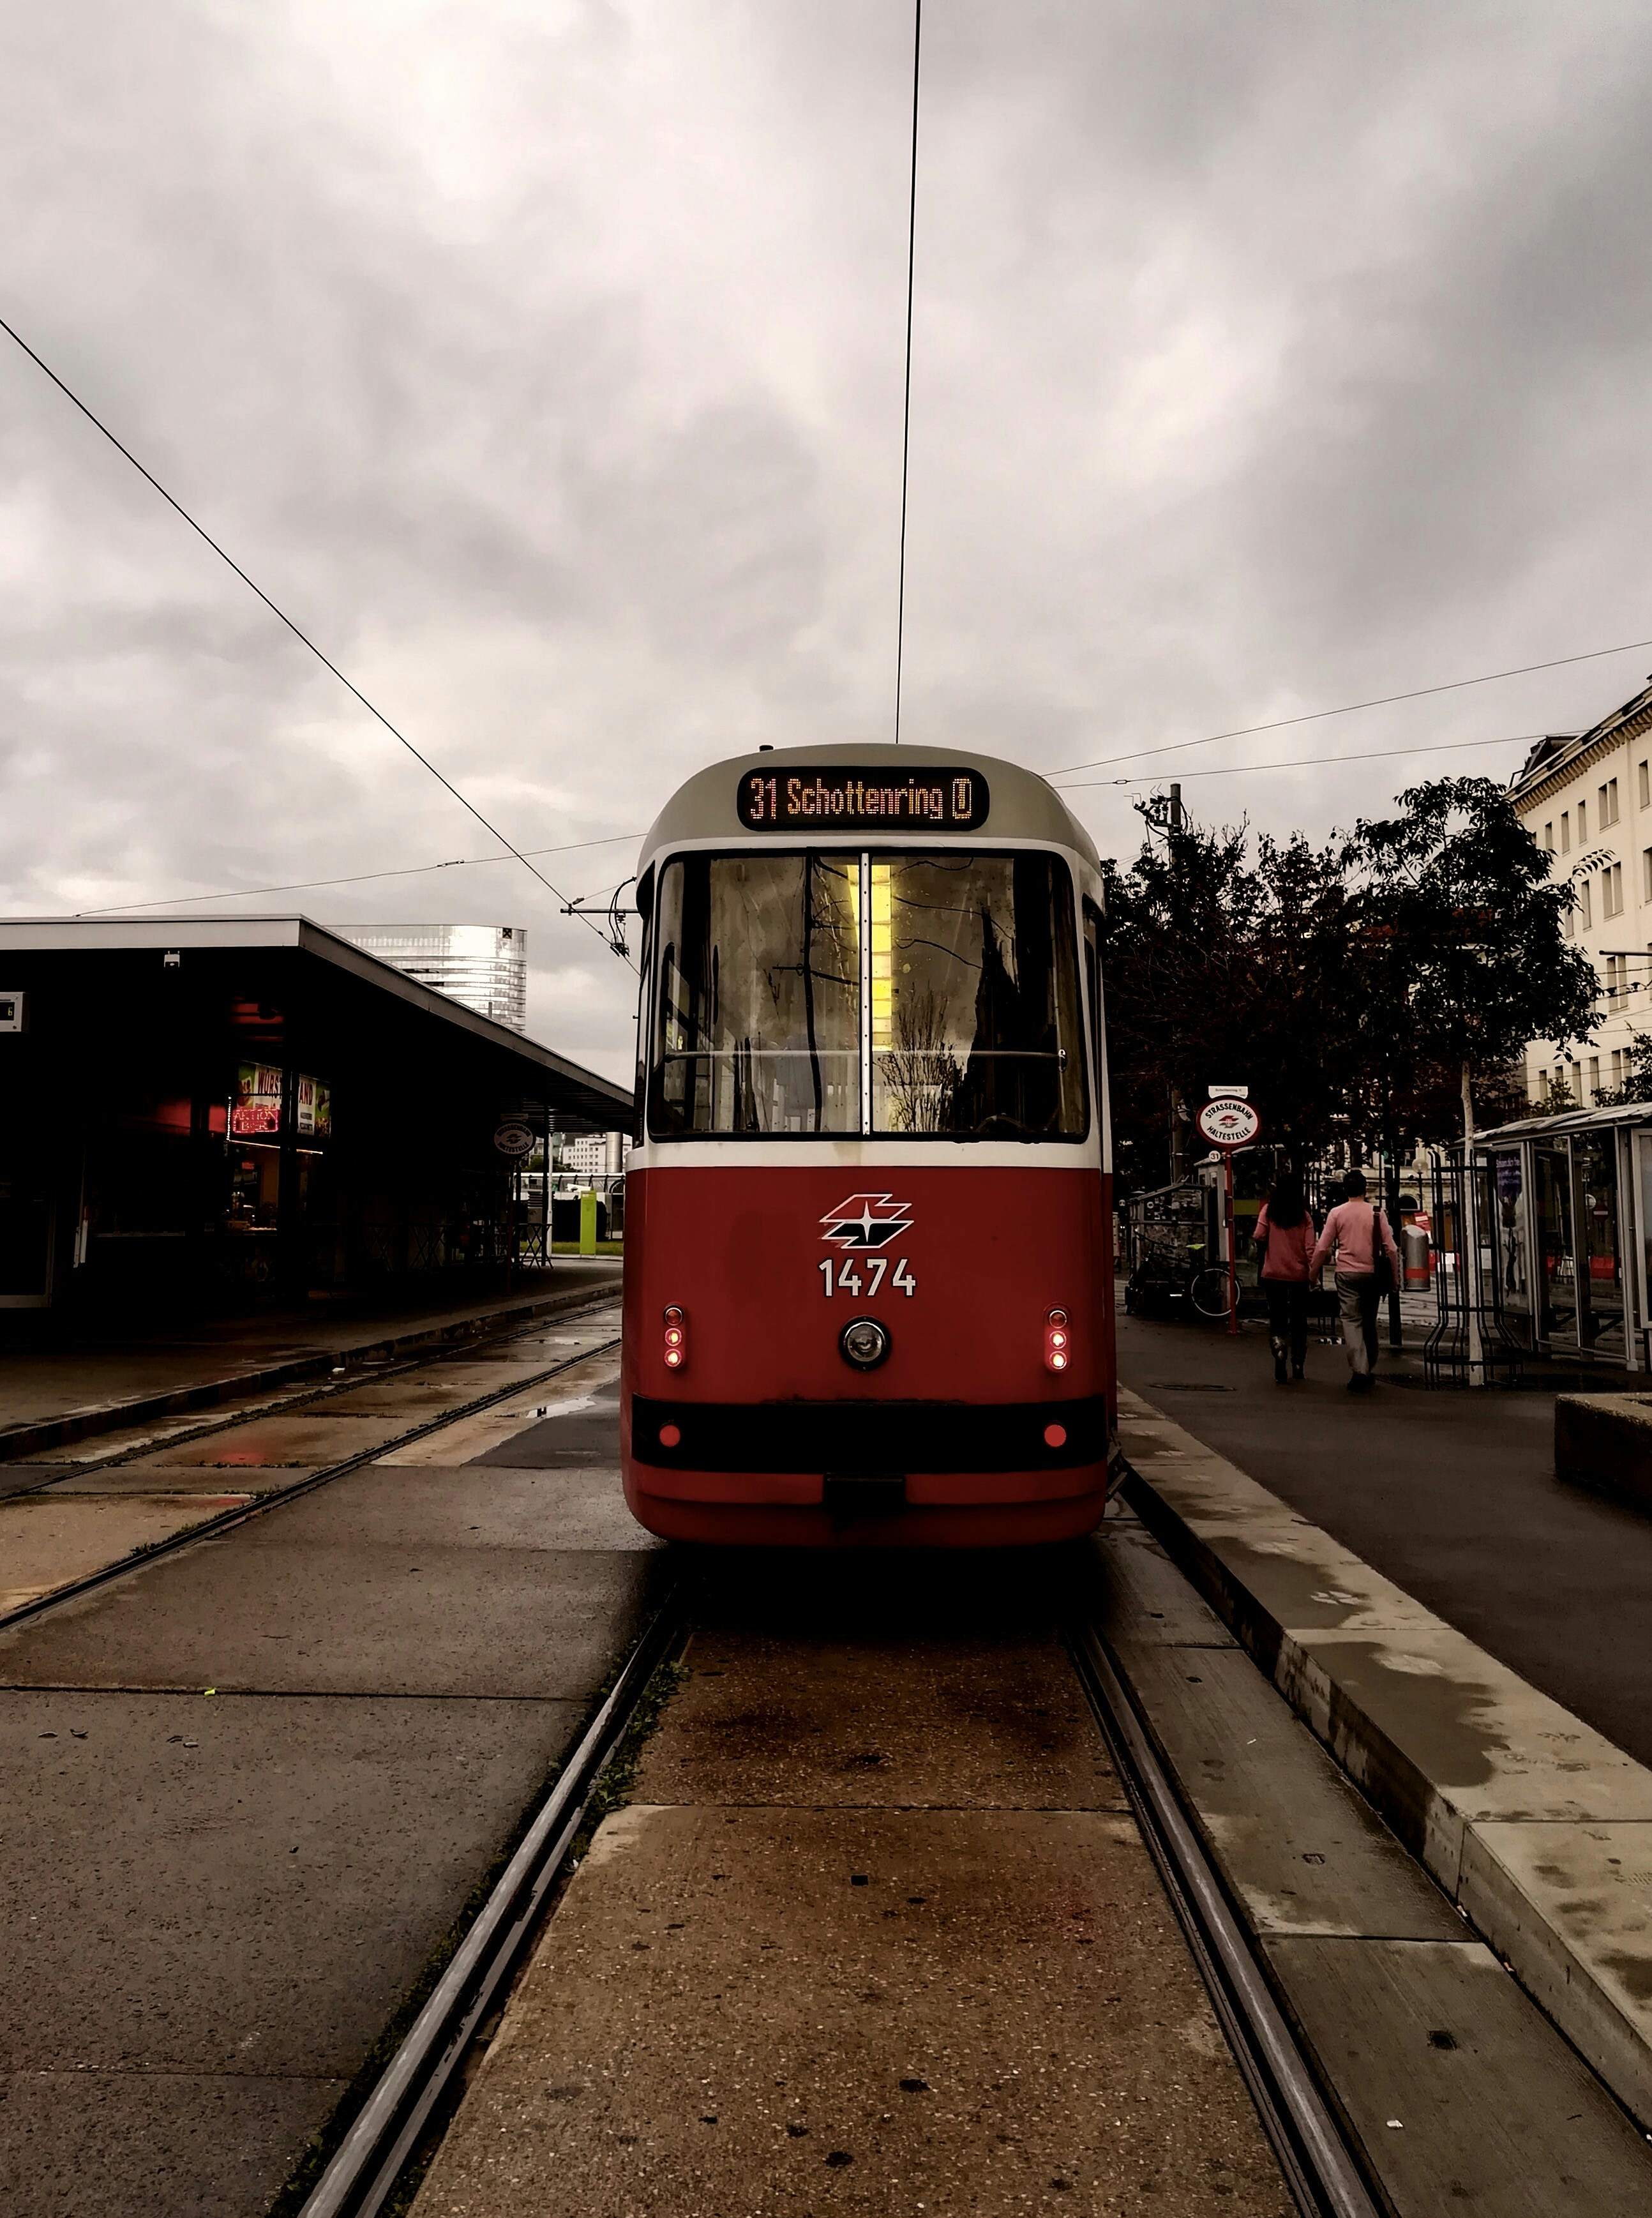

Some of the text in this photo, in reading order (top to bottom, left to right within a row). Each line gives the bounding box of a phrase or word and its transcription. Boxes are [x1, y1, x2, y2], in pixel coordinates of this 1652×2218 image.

[750, 778, 777, 820] 31
[787, 778, 943, 820] Schottenring
[1205, 1103, 1253, 1120] STRASSENBAHN
[1207, 1126, 1251, 1141] HALTESTELLE
[818, 1258, 916, 1297] 1474
